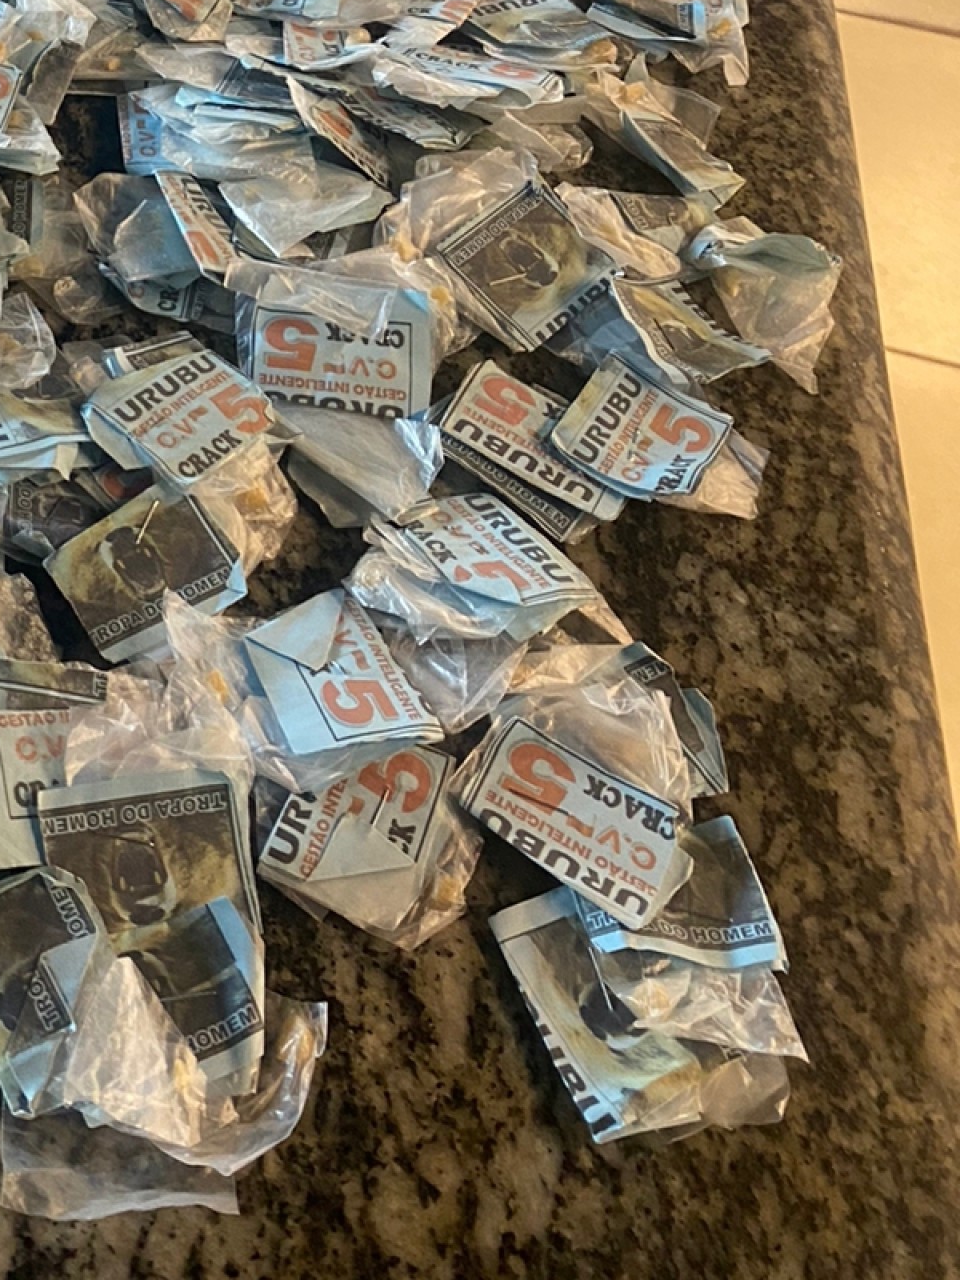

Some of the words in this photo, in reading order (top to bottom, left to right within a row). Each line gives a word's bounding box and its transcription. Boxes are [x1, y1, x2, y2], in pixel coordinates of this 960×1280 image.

[263, 317, 320, 373] 5
[349, 357, 398, 381] C.V
[115, 354, 218, 424] URUBU
[258, 372, 350, 393] INTELIGENTE
[473, 375, 537, 426] 5
[209, 383, 273, 434] 5
[572, 372, 643, 465] URUBU
[649, 402, 712, 453] 5
[178, 429, 244, 478] CRACK
[452, 417, 596, 504] URUBU
[404, 519, 458, 564] RACK
[462, 493, 575, 585] URUBU
[320, 677, 399, 728] 5
[369, 643, 424, 721] INTELIGENTE
[357, 751, 433, 814] 5
[500, 741, 578, 815] 5
[42, 811, 118, 838] HOMEM
[121, 804, 153, 826] DO
[157, 791, 228, 819] TROPA
[485, 789, 594, 861] INTELIGENTE
[581, 772, 679, 842] CRACK
[300, 816, 331, 880] GESTÃO
[478, 806, 652, 919] URUBU
[596, 828, 658, 871] C.V
[691, 920, 773, 945] HOMEM
